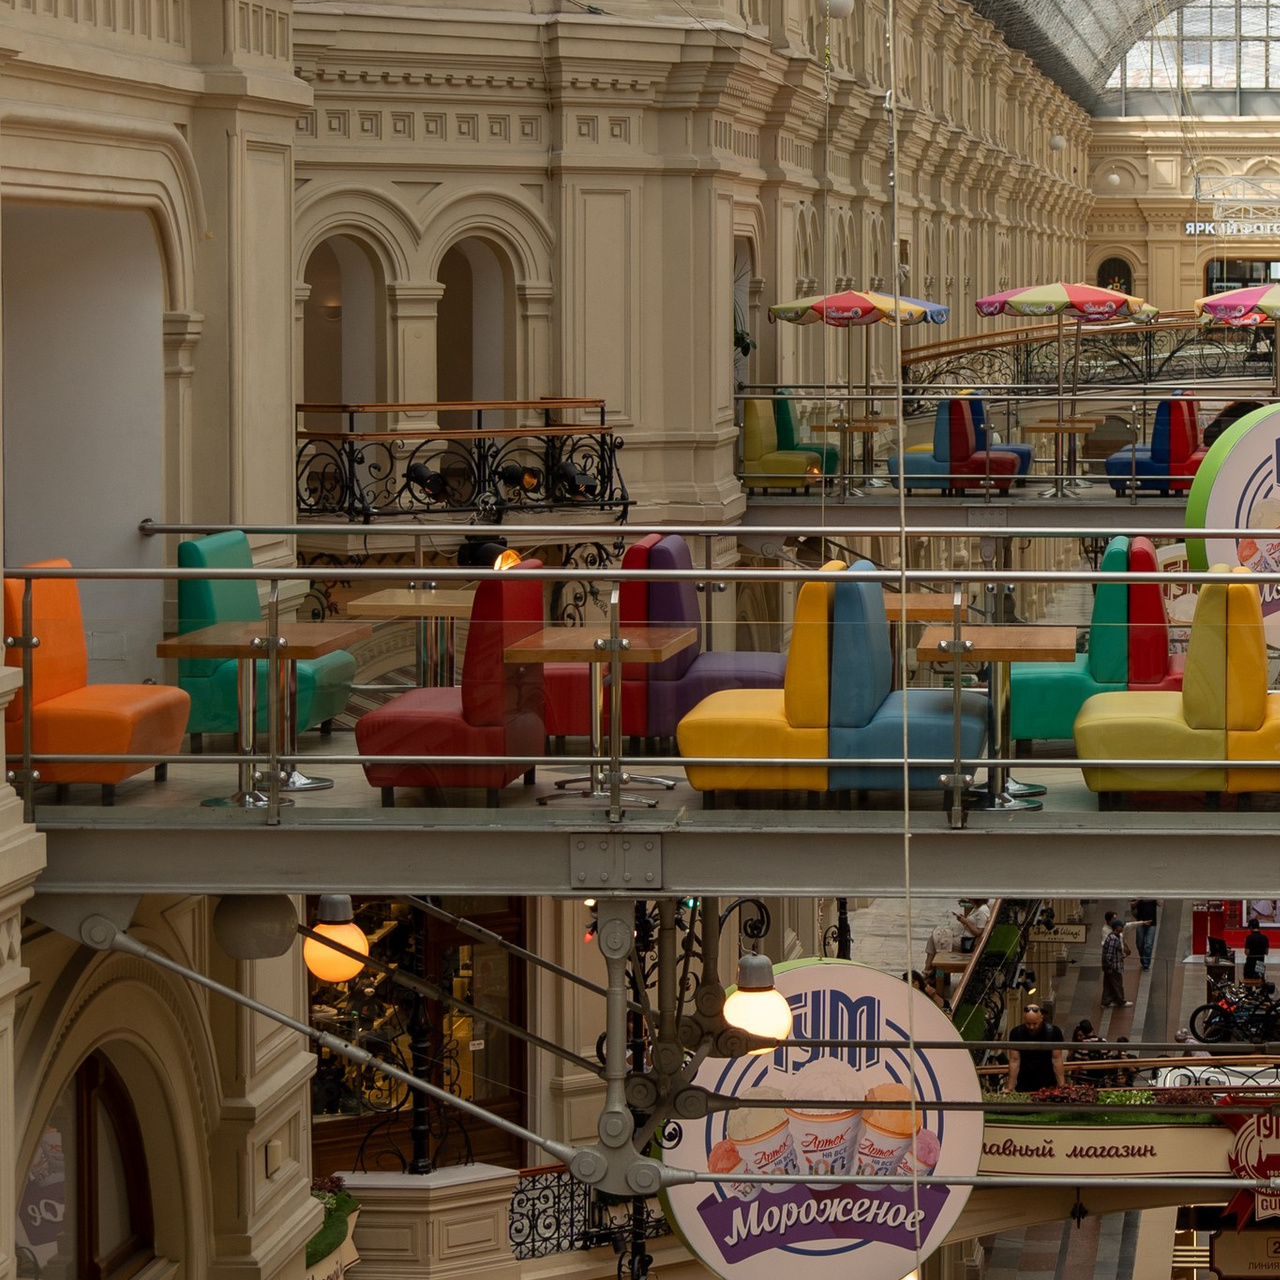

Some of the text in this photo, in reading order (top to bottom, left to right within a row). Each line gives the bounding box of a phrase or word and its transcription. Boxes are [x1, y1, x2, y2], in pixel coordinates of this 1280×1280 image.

[1066, 1143, 1157, 1159] магазин
[724, 1197, 925, 1247] Мороженое
[1248, 1262, 1280, 1270] ЛИНИЯ
